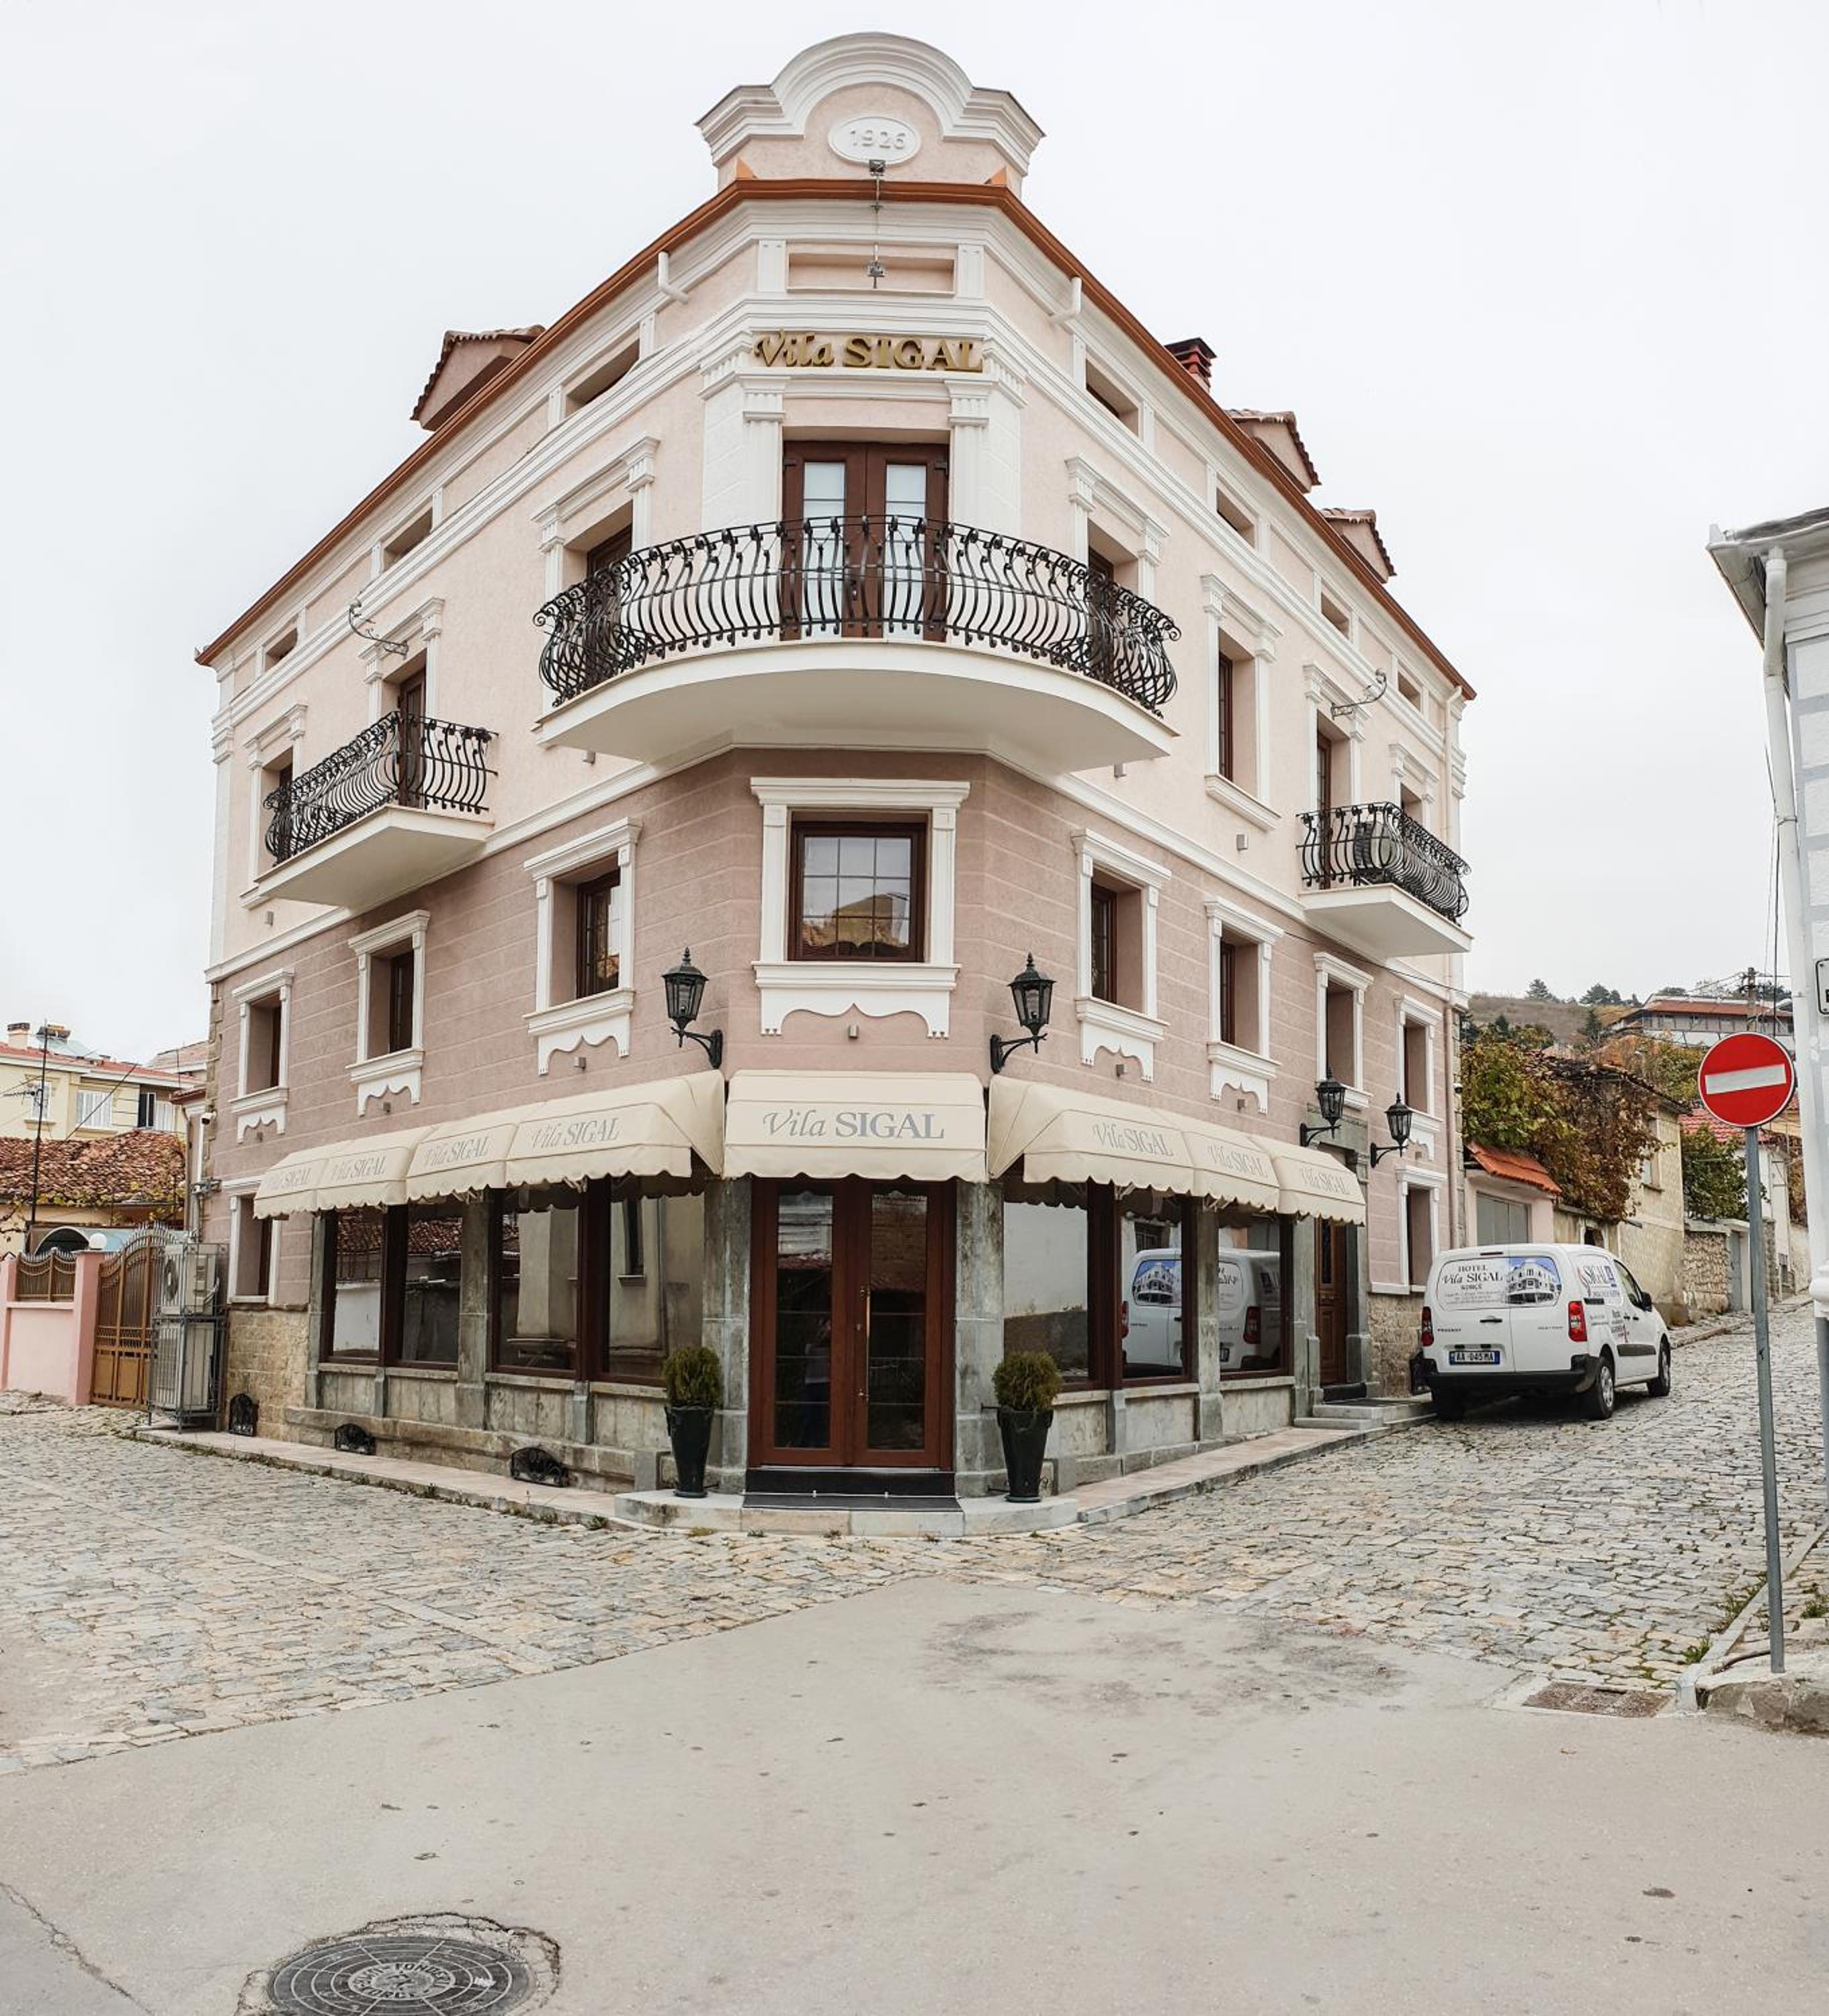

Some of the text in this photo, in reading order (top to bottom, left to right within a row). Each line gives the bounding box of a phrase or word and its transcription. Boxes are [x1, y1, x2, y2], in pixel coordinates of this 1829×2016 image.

[850, 130, 906, 150] 1926
[754, 328, 983, 373] Vila SIGAL
[562, 1117, 621, 1146] SIGAL
[763, 1109, 944, 1140] Vila SIGAL
[450, 1136, 490, 1163] SIGAL
[1093, 1122, 1175, 1157] Vila SIGAL
[353, 1156, 387, 1179] SIGAL
[1230, 1150, 1268, 1178] SIGAL
[1318, 1171, 1350, 1195] SIGAL
[1443, 1271, 1503, 1284] Vila SIGAL
[1458, 1264, 1488, 1272] HOTEL
